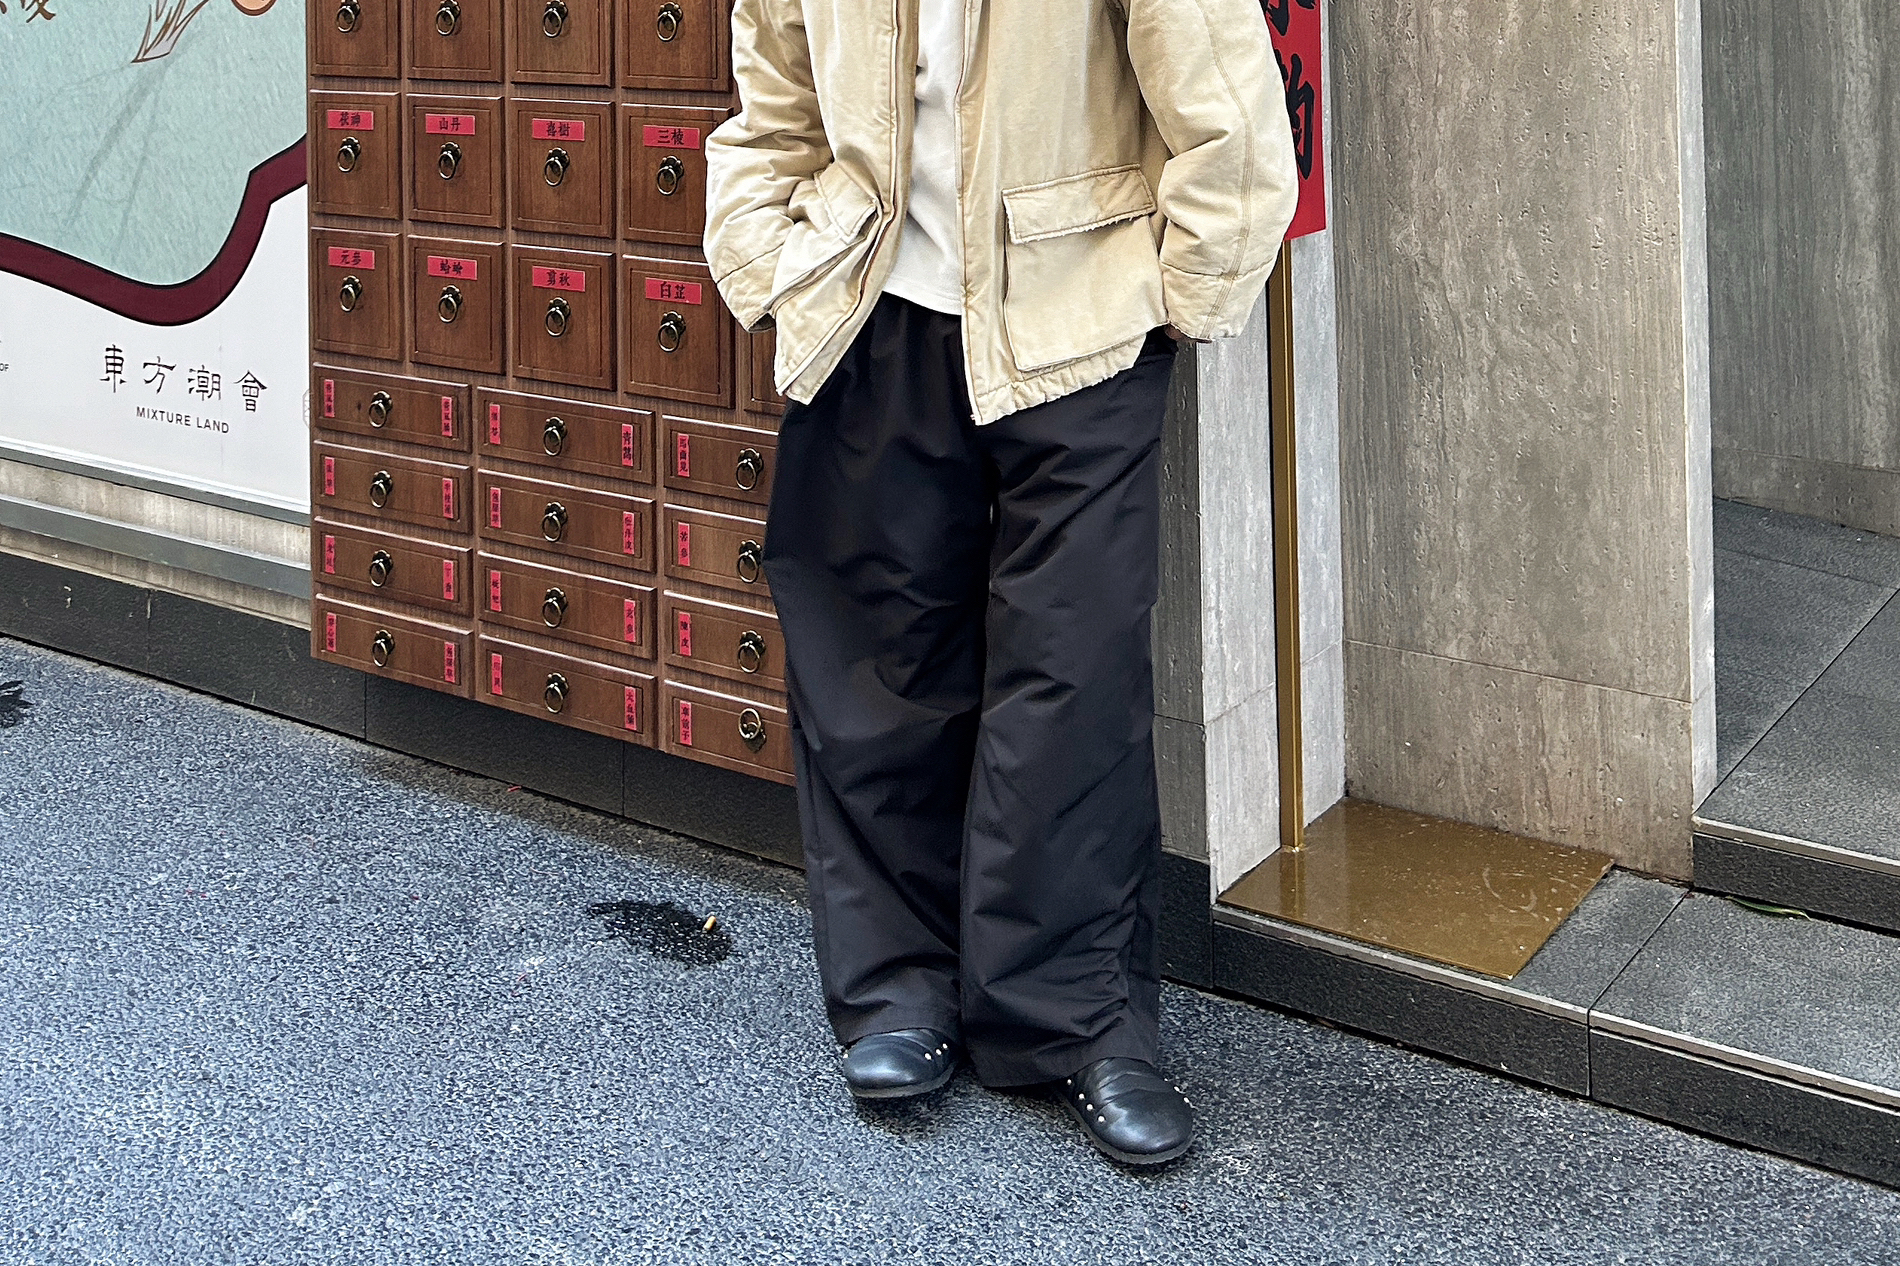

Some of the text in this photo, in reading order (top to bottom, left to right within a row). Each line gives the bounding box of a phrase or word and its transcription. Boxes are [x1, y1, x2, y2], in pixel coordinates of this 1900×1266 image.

[660, 282, 686, 300] 白芷
[100, 344, 268, 413] 東方潮會
[136, 406, 230, 434] MIXTURE LAND
